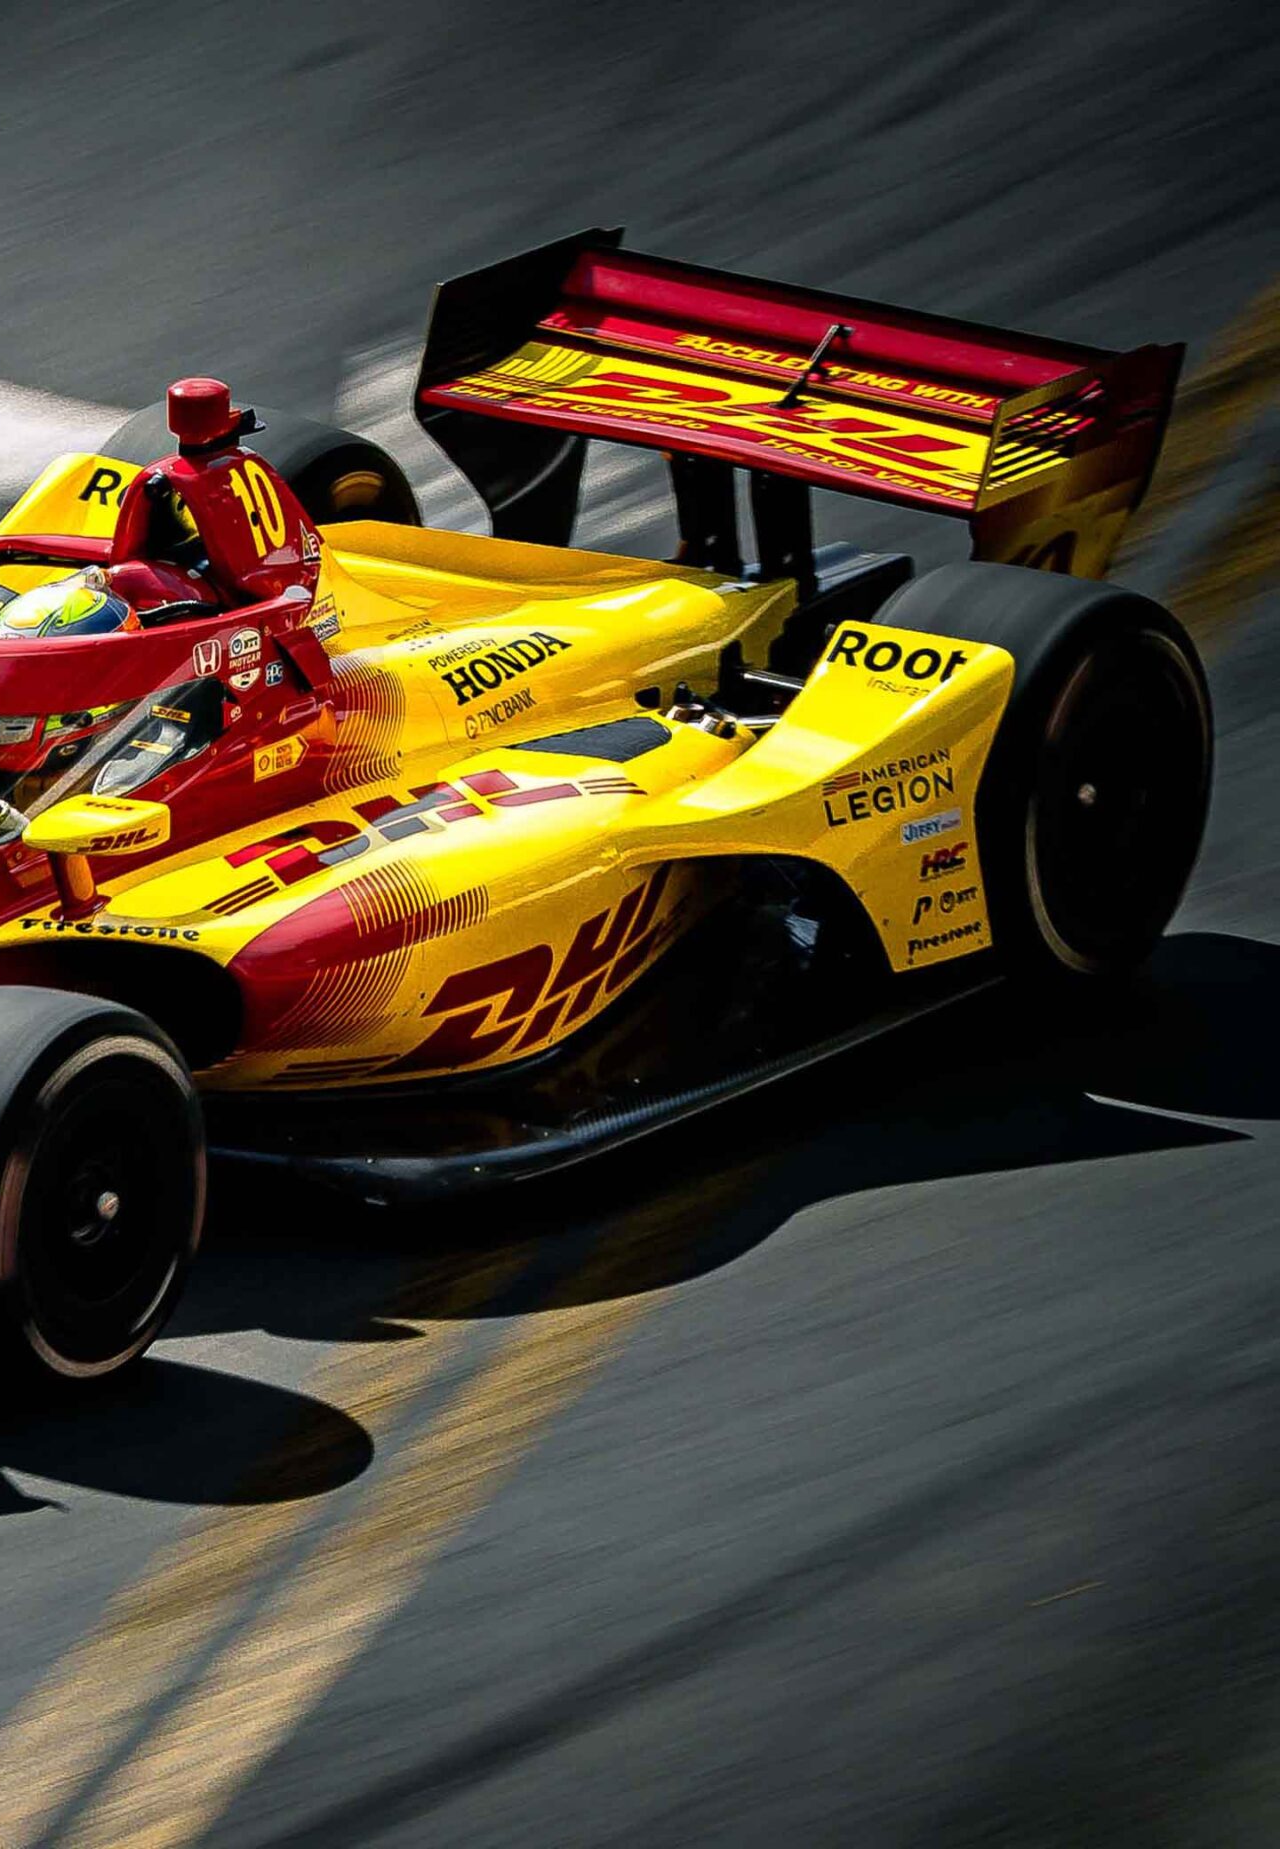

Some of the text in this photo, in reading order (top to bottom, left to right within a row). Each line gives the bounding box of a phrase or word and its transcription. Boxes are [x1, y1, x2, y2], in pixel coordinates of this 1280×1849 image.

[677, 334, 994, 409] ACCELETING WITH
[569, 404, 711, 430] Quevedo
[78, 467, 129, 509] R
[758, 437, 974, 501] Hector Varela
[229, 459, 286, 557] 10
[428, 641, 482, 671] POWERED
[440, 631, 573, 706] HONDA
[827, 629, 968, 684] Root
[861, 748, 951, 785] AMERICAN
[823, 766, 955, 829] LEGION
[89, 827, 160, 852] DHL
[20, 917, 201, 942] Firestone
[908, 921, 982, 958] Firestone
[380, 862, 671, 1074] DHL
